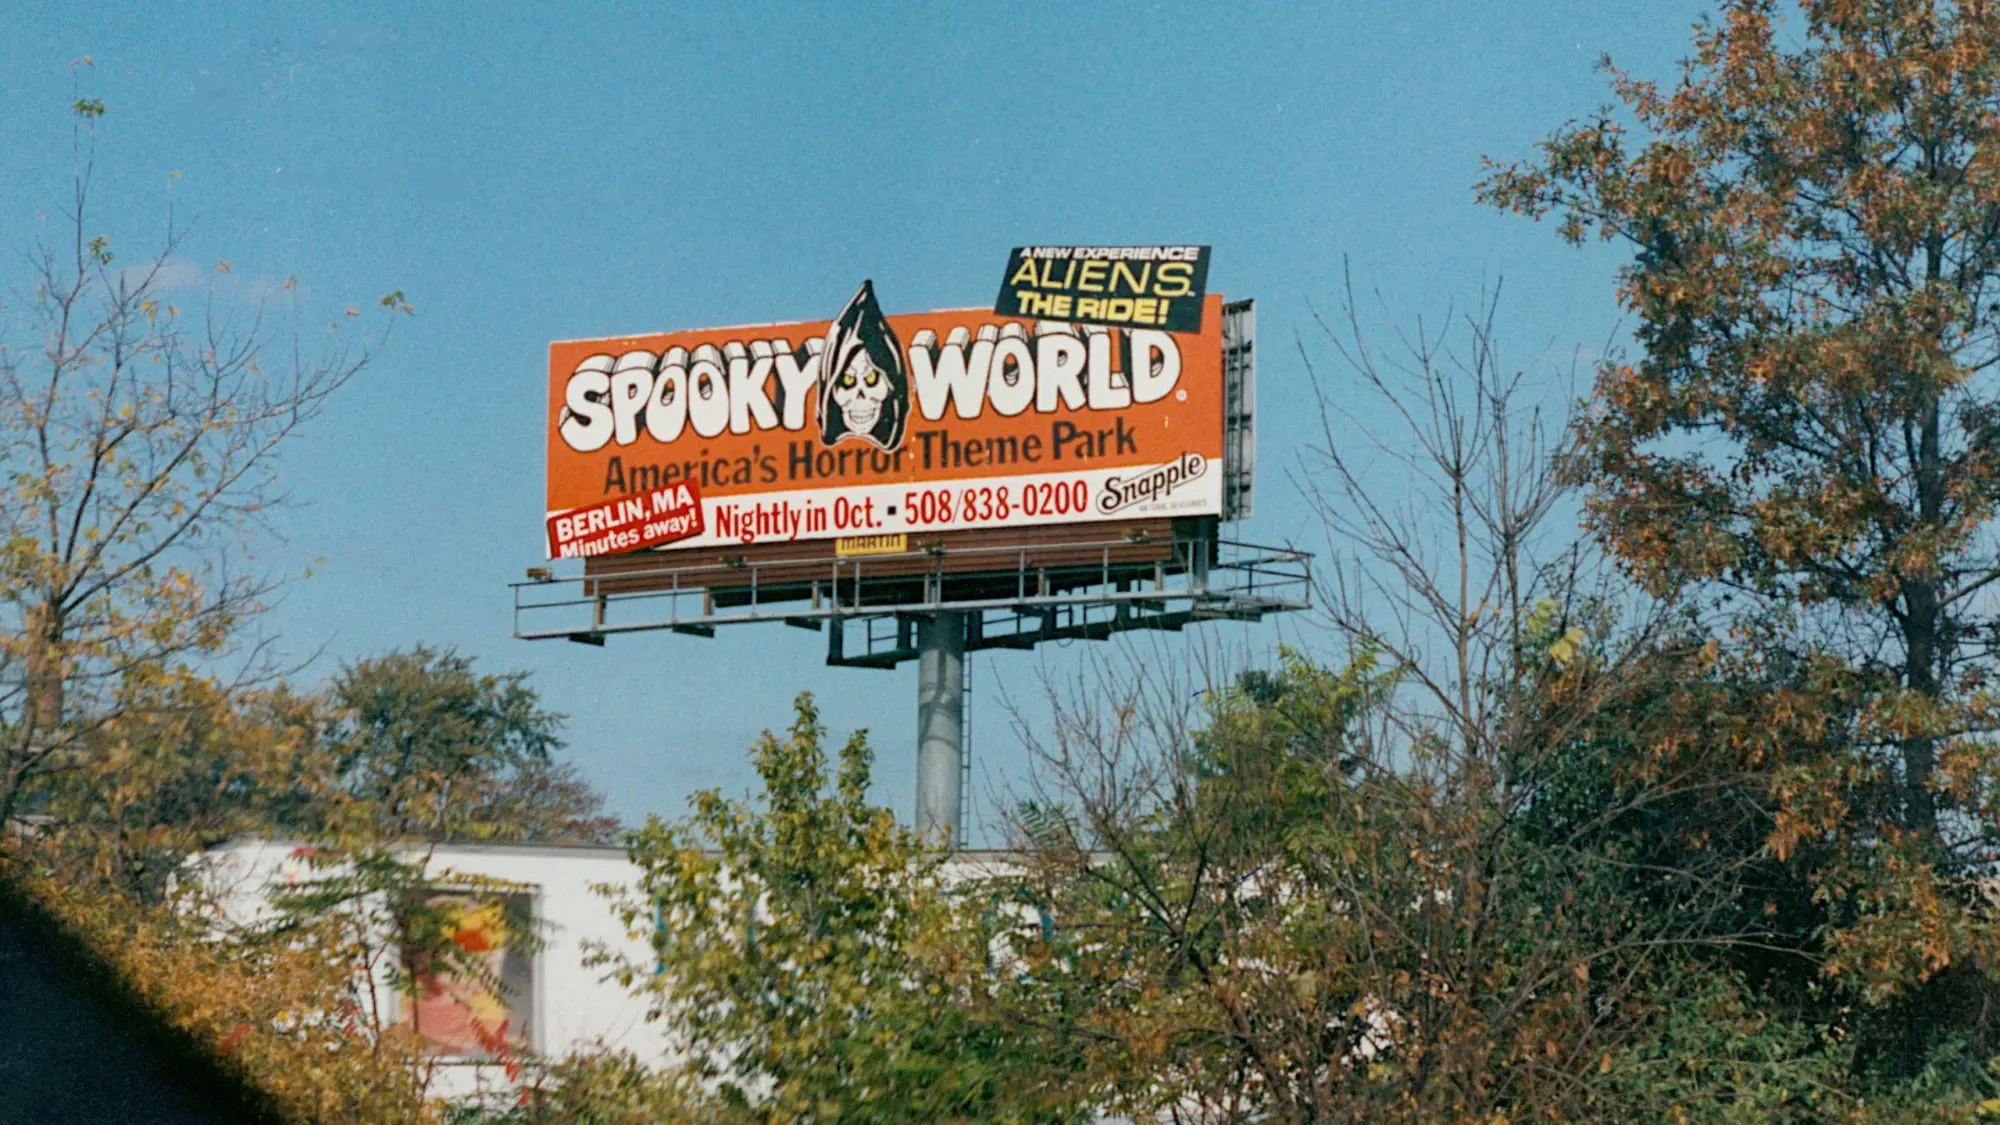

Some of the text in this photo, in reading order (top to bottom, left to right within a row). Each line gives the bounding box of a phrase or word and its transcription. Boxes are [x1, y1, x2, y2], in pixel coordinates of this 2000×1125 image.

[1010, 257, 1195, 297] ALIENS
[1020, 247, 1200, 260] A NEW EXPERIENCE
[1016, 291, 1170, 325] THE RIDE!
[559, 322, 1182, 452] SPOOKY WORLD
[603, 417, 1137, 495] America's Horror Theme Park
[1101, 451, 1200, 510] Snapple
[556, 485, 694, 542] BERLIN, MA
[559, 507, 698, 559] Minutes away!
[716, 480, 1088, 542] Nightly in Oct. 508/838-0200
